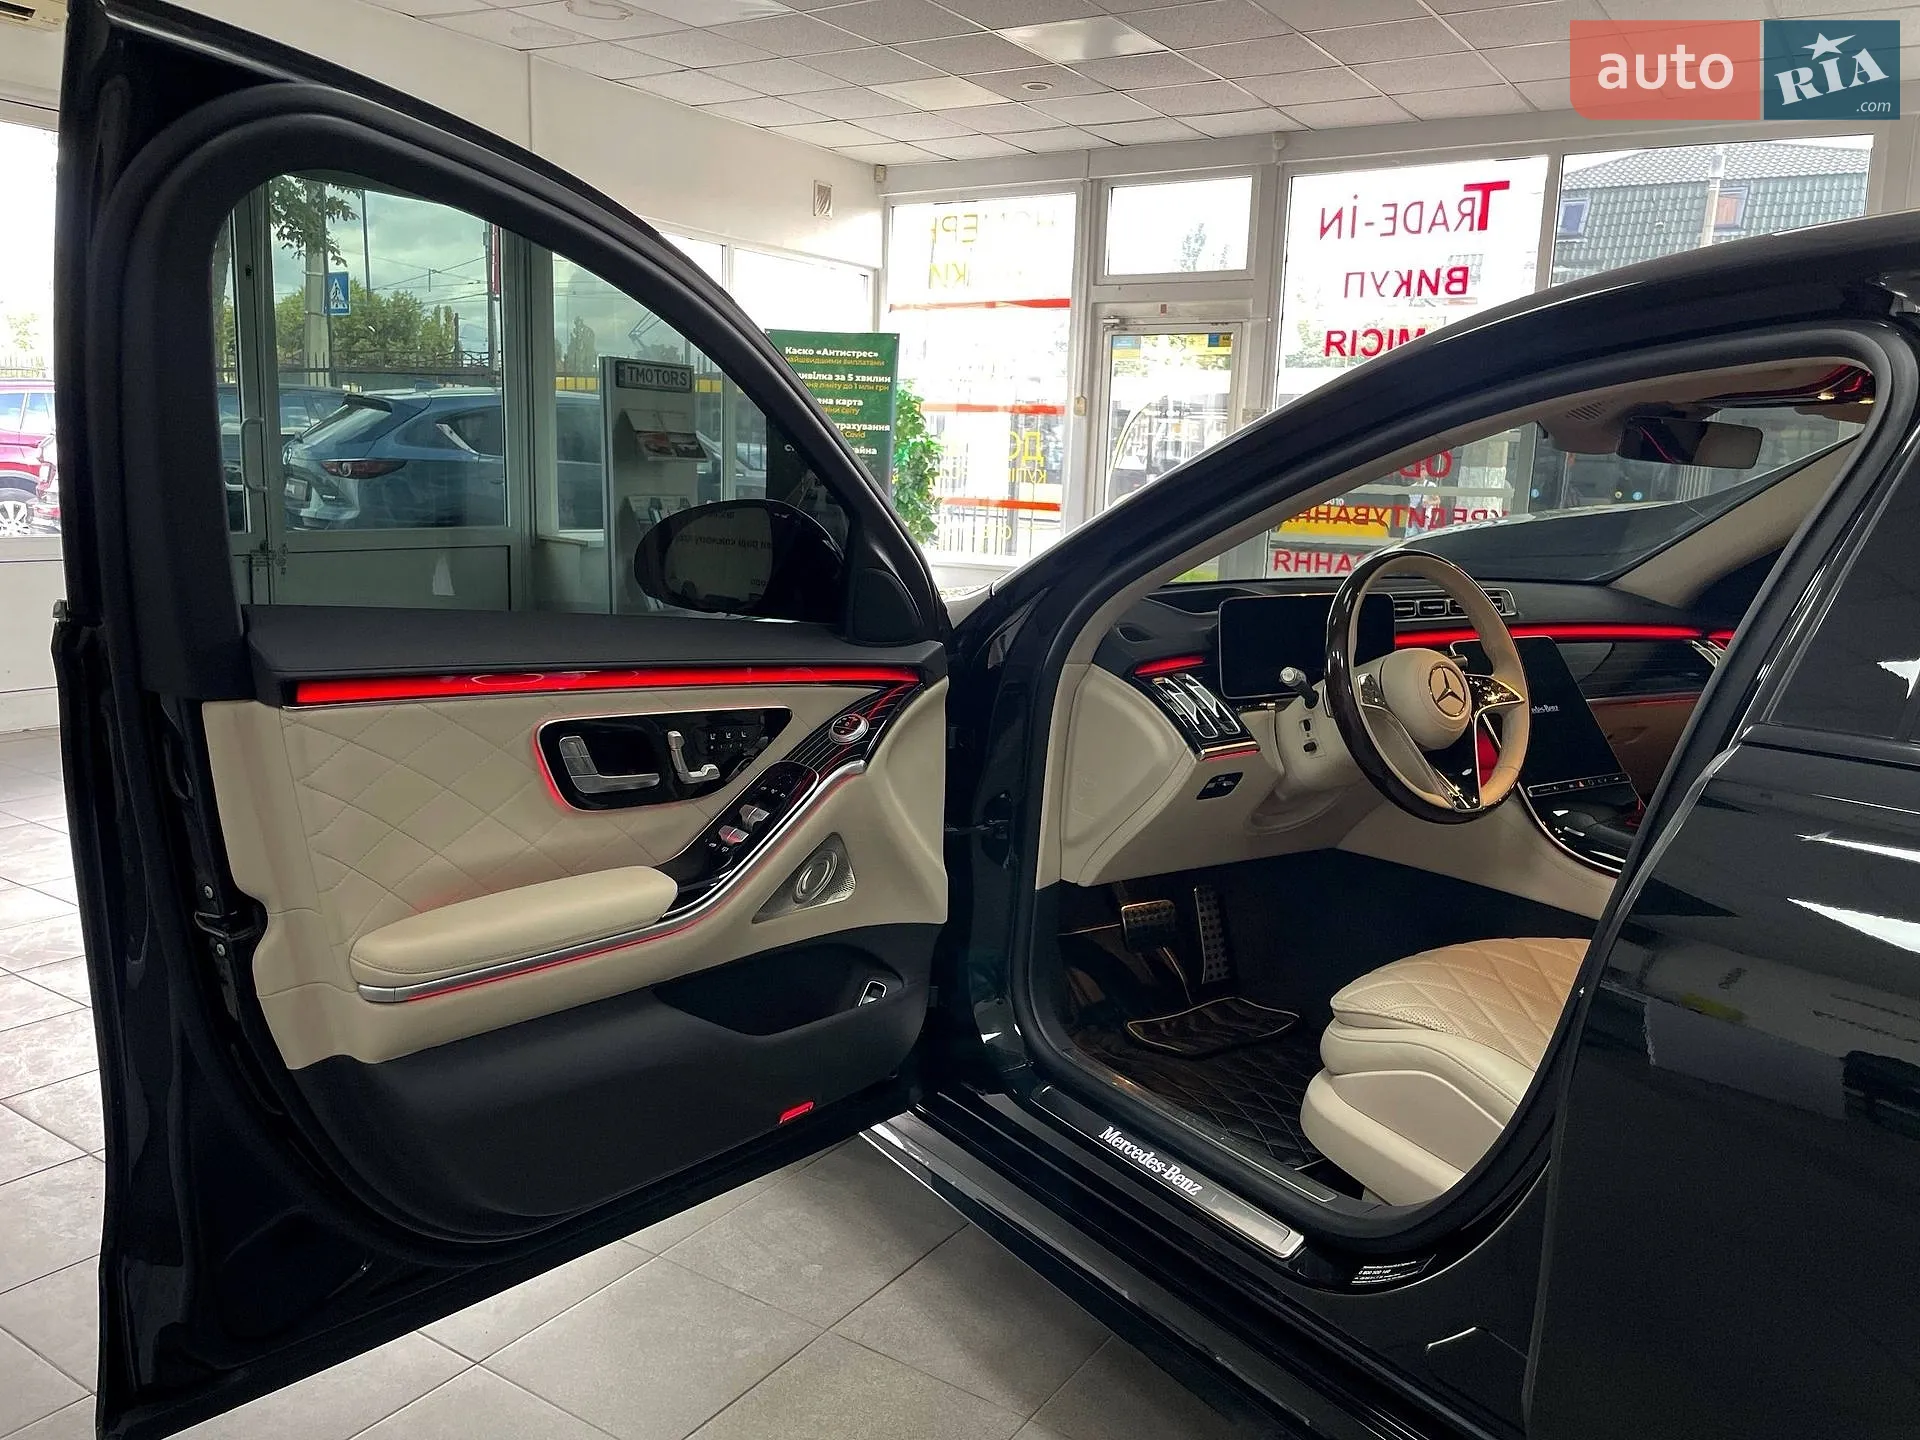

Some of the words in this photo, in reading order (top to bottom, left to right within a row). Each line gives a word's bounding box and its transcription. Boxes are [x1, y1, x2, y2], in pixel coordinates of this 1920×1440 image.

[785, 346, 814, 356] Каско
[816, 348, 879, 358] «Антистрес»
[627, 365, 688, 387] TMOTORS
[847, 373, 853, 382] 5
[855, 375, 891, 383] хвилин
[836, 398, 864, 407] карта
[1098, 1126, 1203, 1196] Mercedes-Benz
